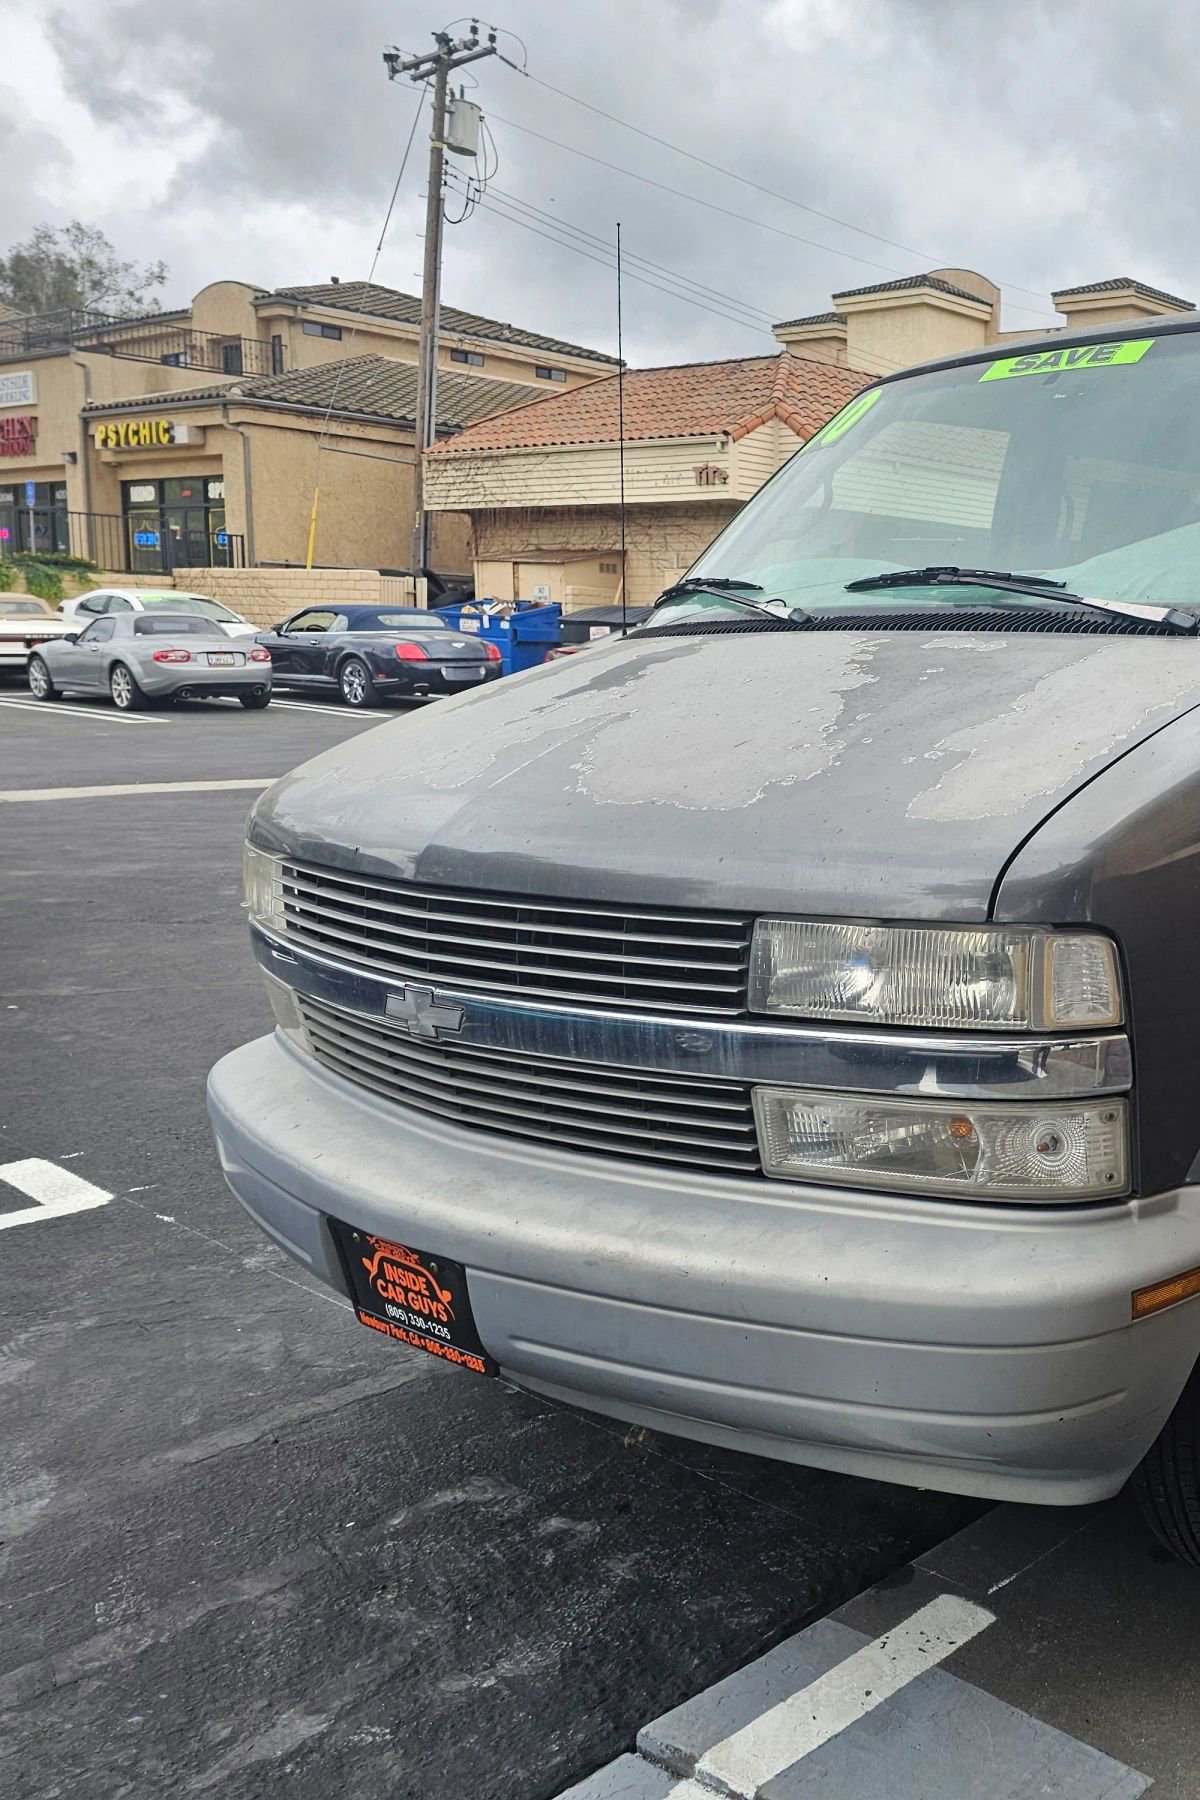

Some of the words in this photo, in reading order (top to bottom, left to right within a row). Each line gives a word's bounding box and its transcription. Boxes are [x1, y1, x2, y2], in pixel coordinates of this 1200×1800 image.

[1008, 344, 1125, 375] SAVE
[97, 420, 170, 448] PSYCHIC
[383, 1261, 430, 1296] INSIDE
[376, 1278, 408, 1306] CAR
[407, 1291, 448, 1322] GUYS
[385, 1303, 409, 1325] (805)
[408, 1313, 451, 1340] 330-1235
